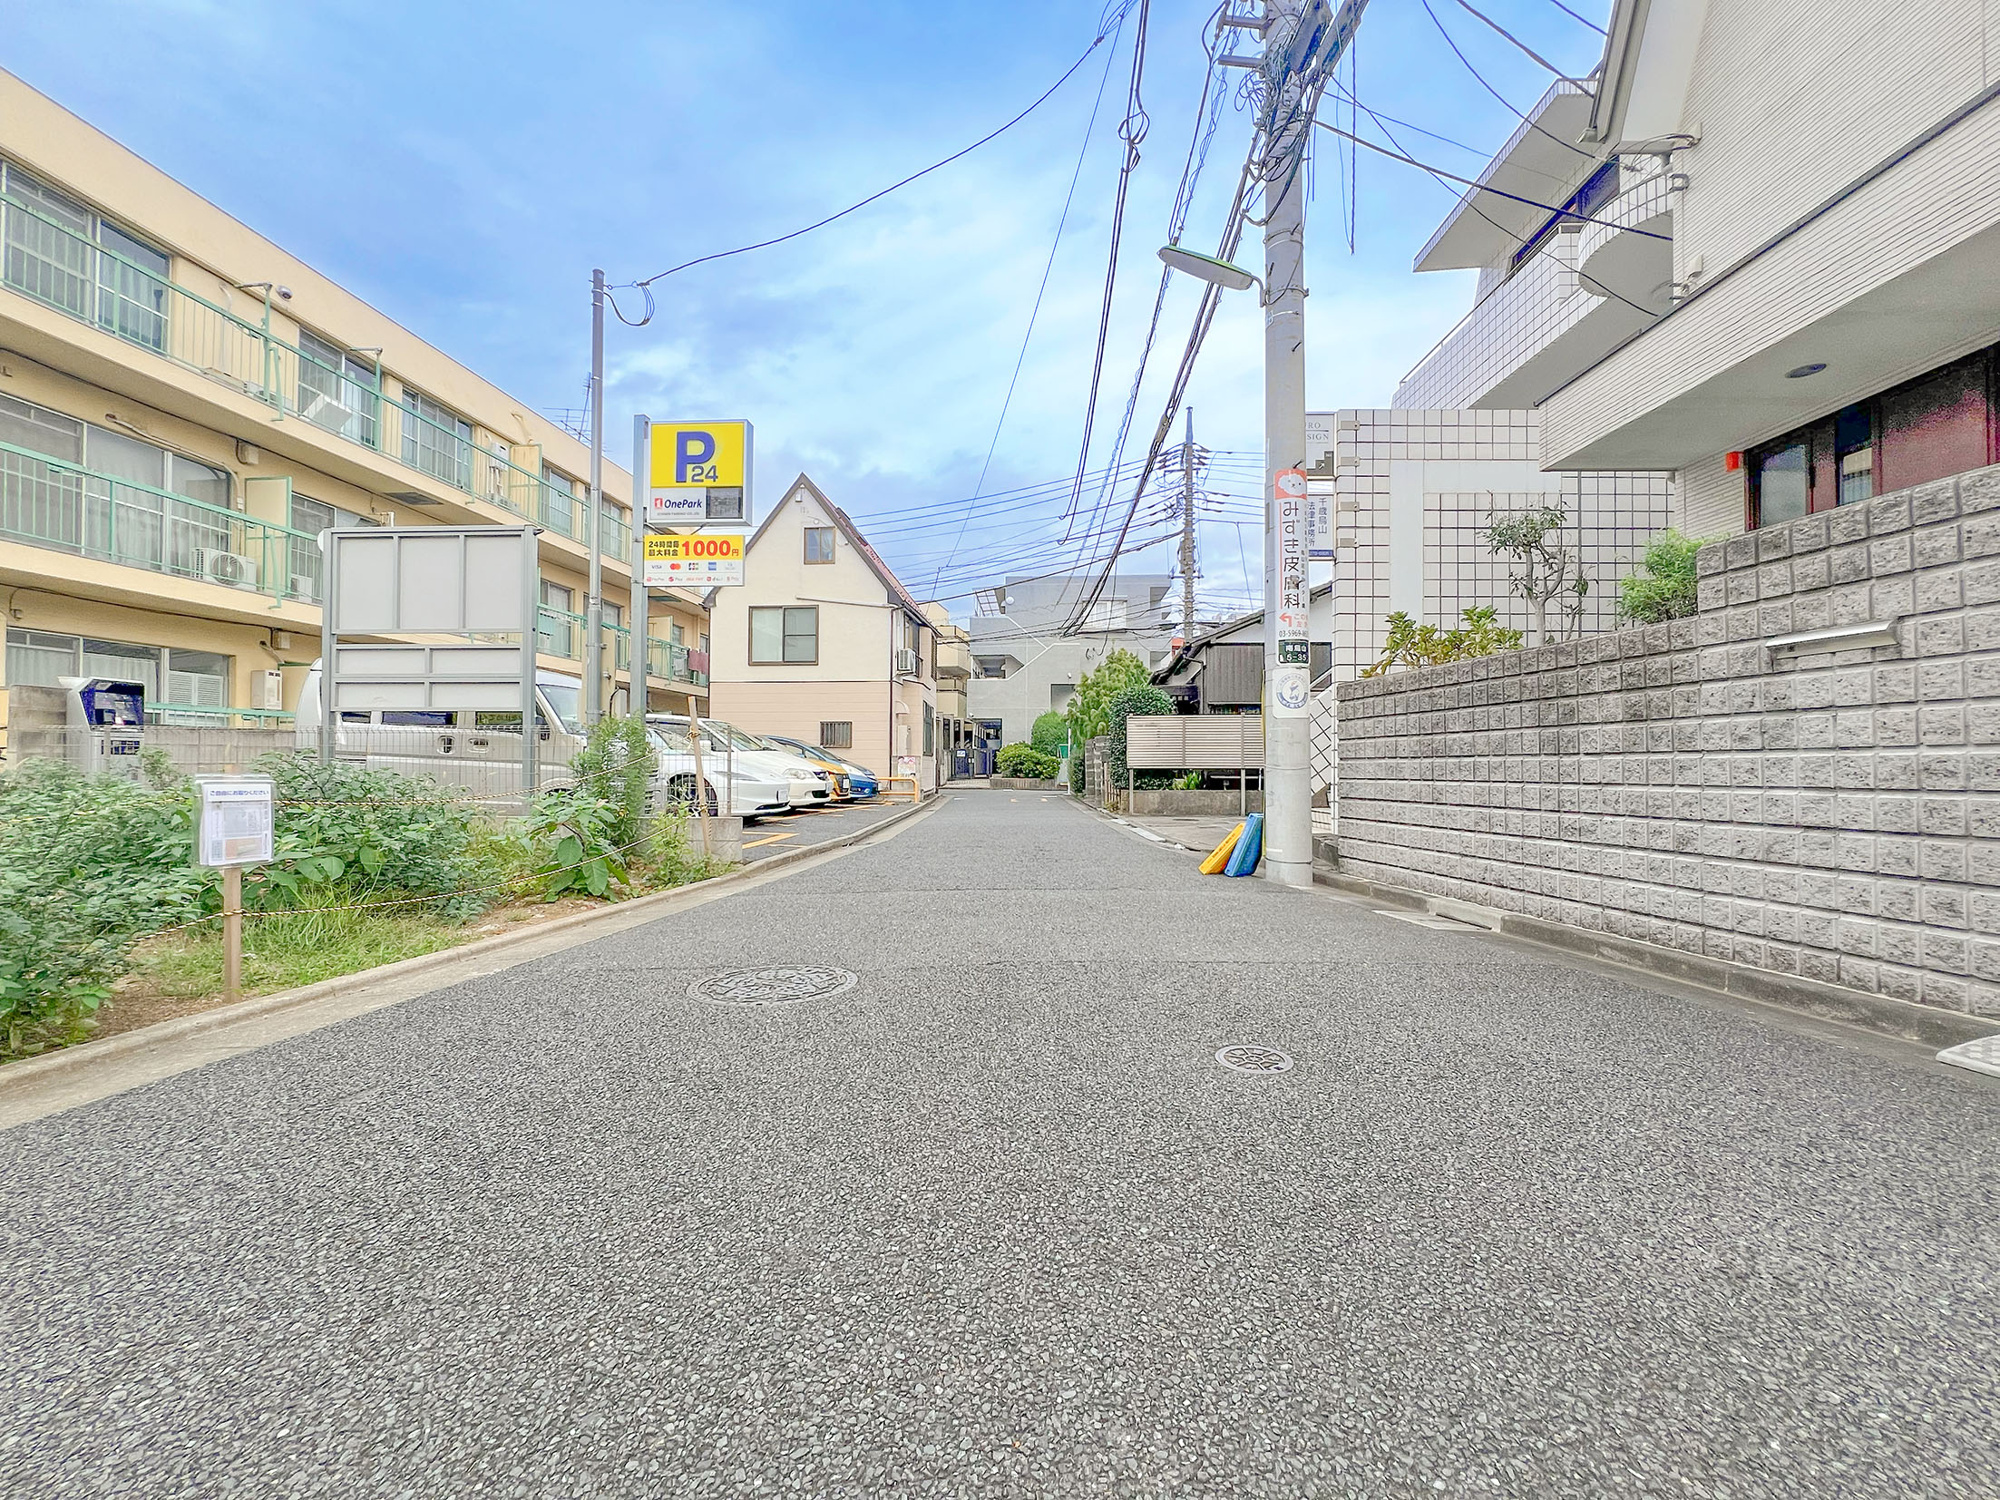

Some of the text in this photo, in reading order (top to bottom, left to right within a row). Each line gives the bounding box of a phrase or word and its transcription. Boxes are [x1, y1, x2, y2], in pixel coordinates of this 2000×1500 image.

[1305, 421, 1321, 430] RO
[676, 431, 716, 483] P
[691, 465, 718, 483] 24
[664, 498, 703, 509] OnePark
